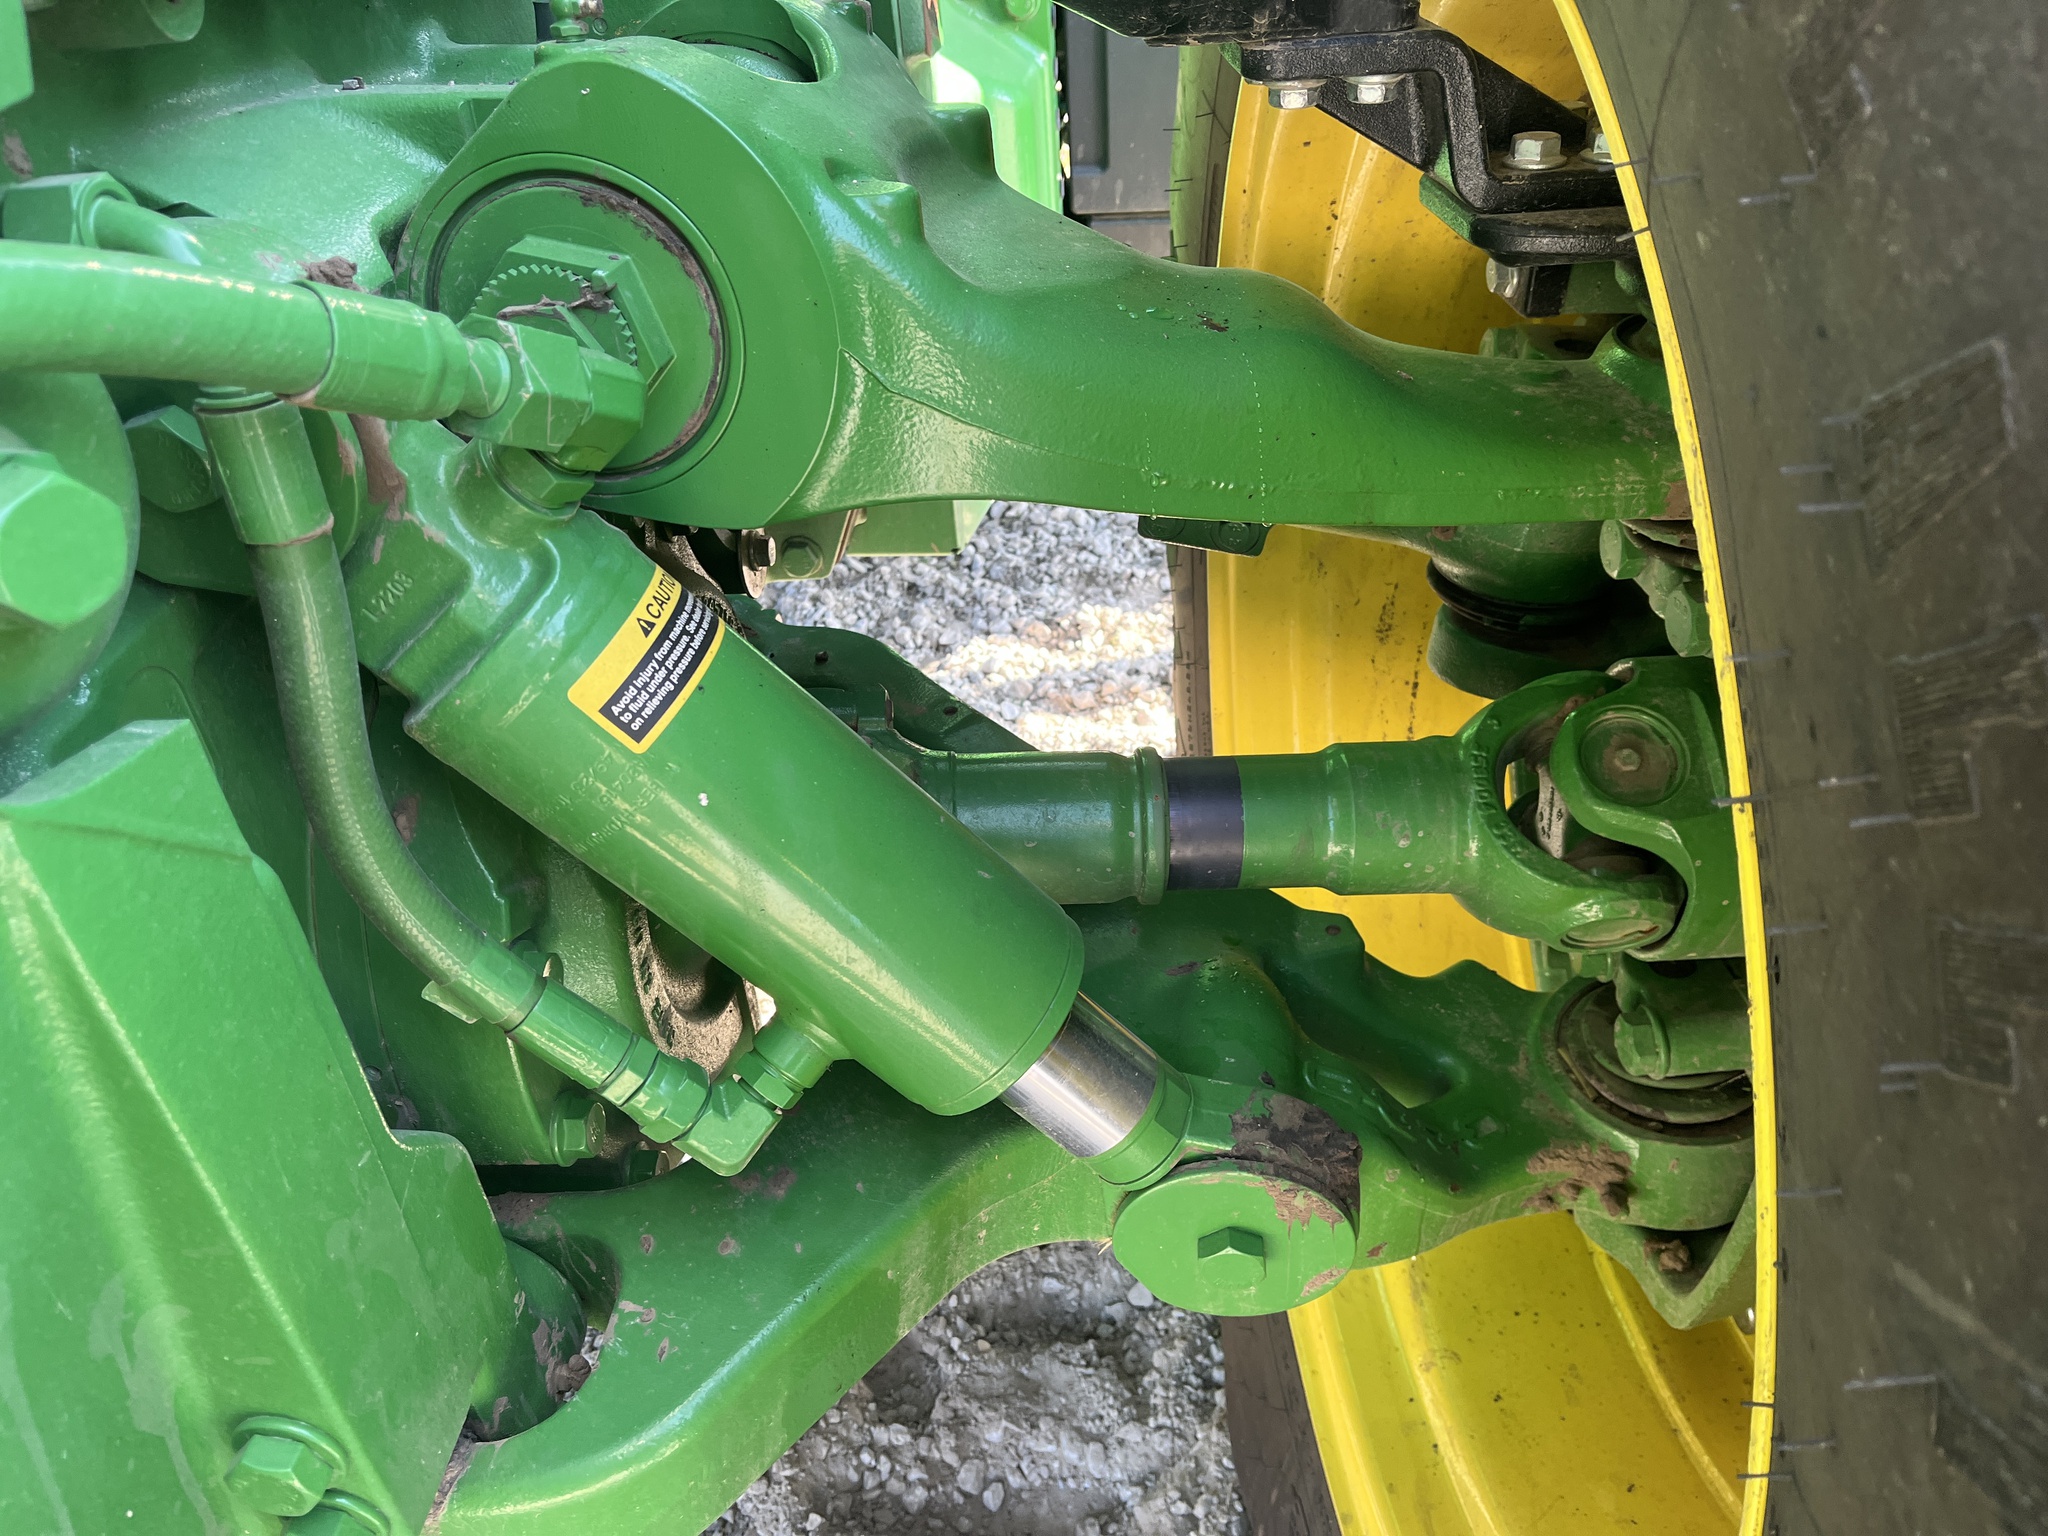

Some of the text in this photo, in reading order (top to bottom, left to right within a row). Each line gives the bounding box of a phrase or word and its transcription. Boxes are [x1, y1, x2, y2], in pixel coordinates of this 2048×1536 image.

[645, 572, 676, 619] CAUTIO
[611, 685, 638, 716] Avoid
[633, 660, 661, 690] injury
[654, 638, 673, 662] from
[669, 610, 690, 642] machine
[619, 710, 633, 724] to
[632, 690, 650, 715] fluid
[646, 666, 669, 693] under
[664, 634, 691, 670] pressure.
[685, 615, 698, 634] See
[630, 715, 645, 731] on
[641, 680, 675, 720] relieving
[669, 648, 696, 685] pressure
[689, 628, 706, 650] before
